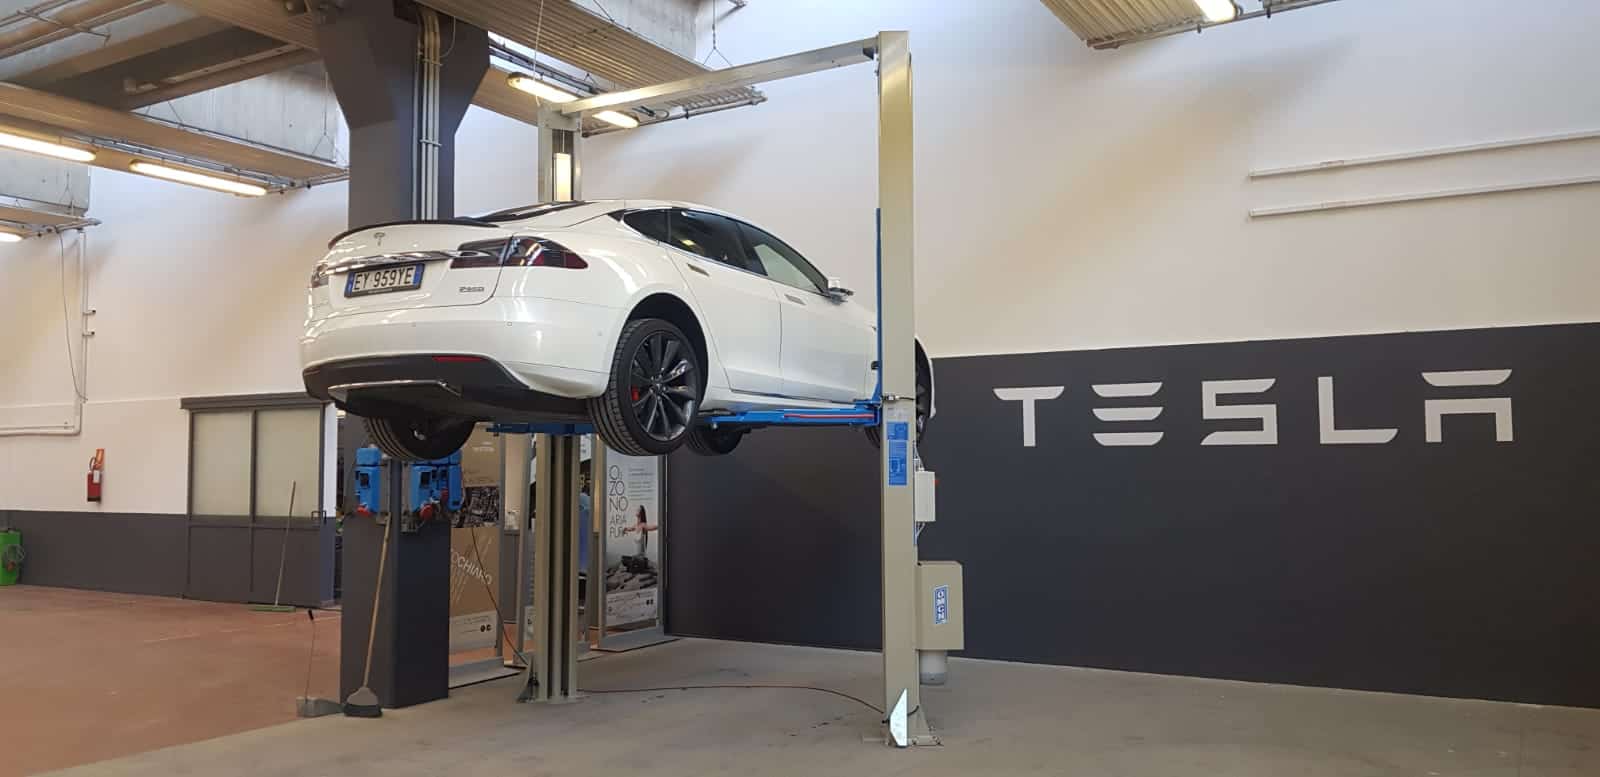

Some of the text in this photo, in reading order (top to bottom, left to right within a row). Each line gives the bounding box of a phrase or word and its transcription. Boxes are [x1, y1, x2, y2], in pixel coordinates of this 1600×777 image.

[354, 273, 370, 290] EY
[993, 369, 1513, 446] TESLA
[609, 481, 625, 496] ZO
[609, 496, 629, 512] NO
